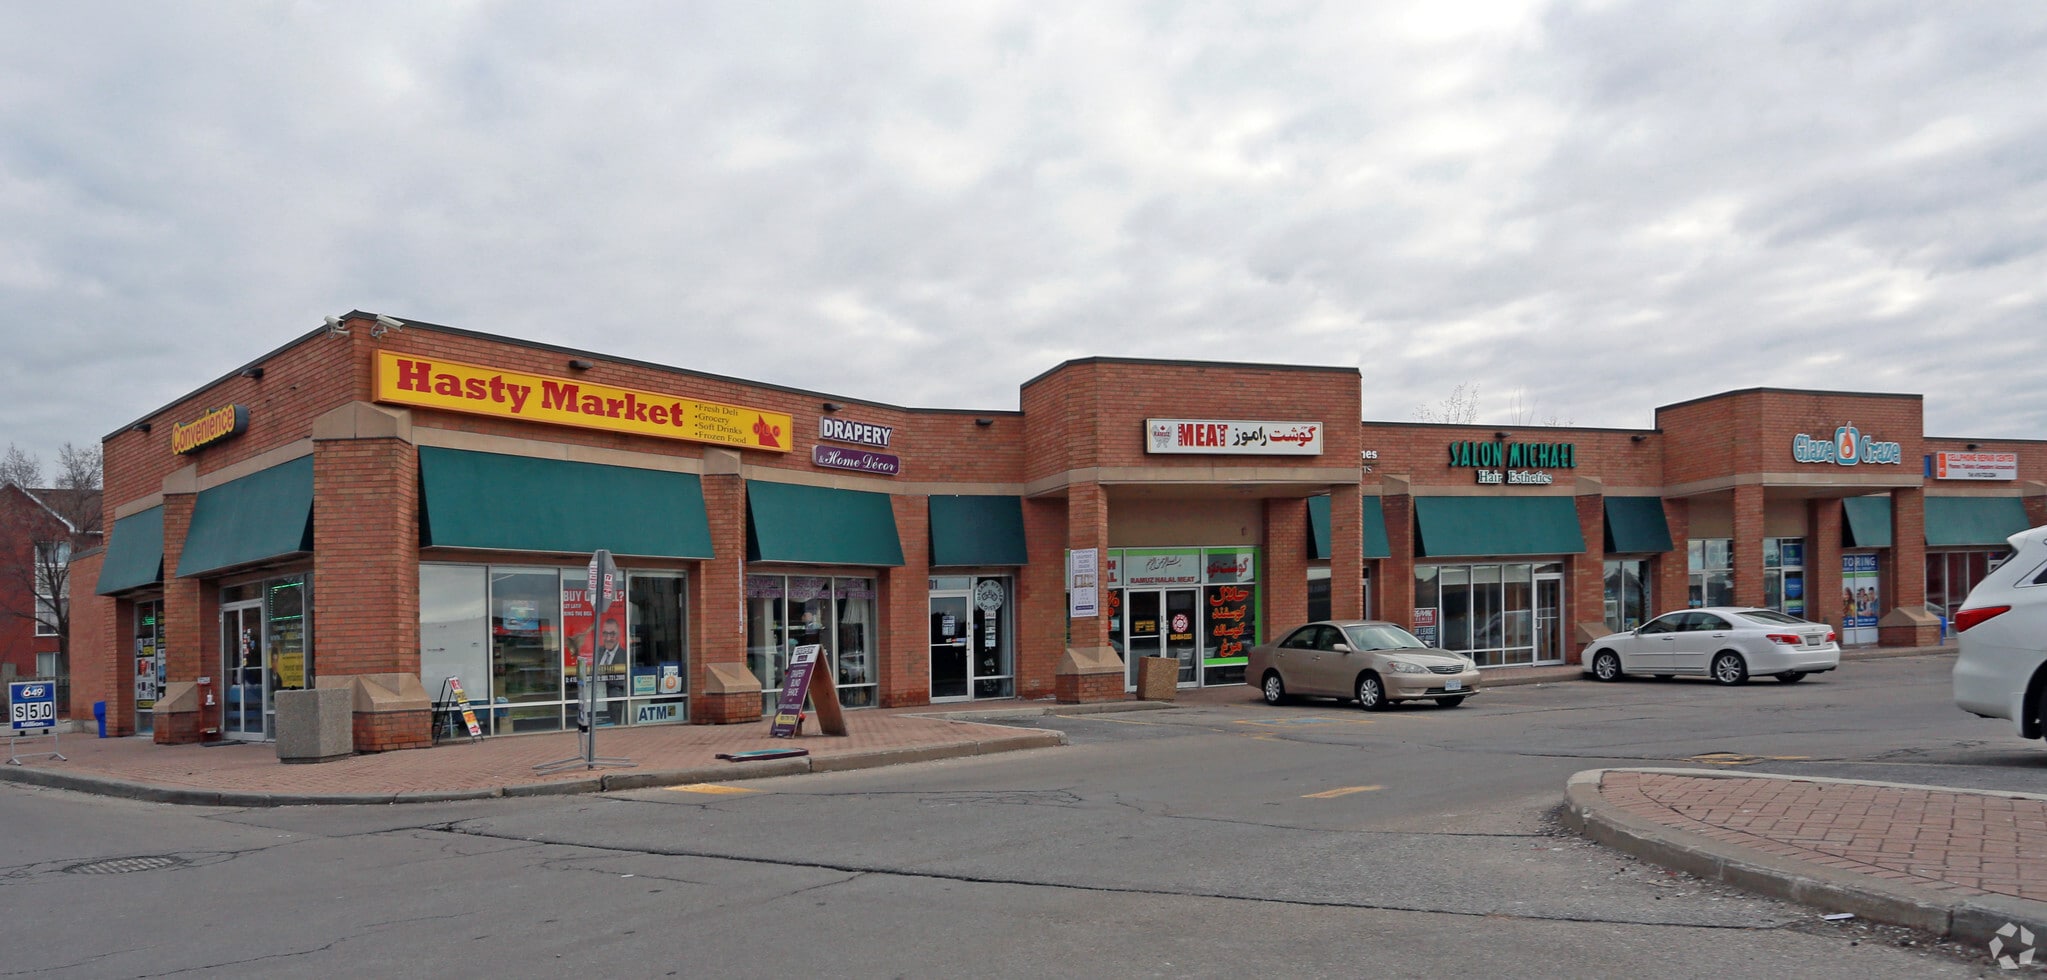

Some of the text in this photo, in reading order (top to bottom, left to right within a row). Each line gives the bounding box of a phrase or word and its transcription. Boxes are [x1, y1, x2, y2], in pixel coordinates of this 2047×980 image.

[397, 359, 683, 427] Hasty Market
[698, 404, 738, 417] Fresh Deli
[698, 413, 729, 426] Grocery
[173, 405, 234, 454] Convenience
[698, 423, 742, 435] Soft Drinks
[698, 431, 747, 444] Frozen Food
[822, 418, 891, 446] DRAPERY
[1177, 423, 1229, 447] MEAT
[1232, 425, 1317, 447] گوشت راموز
[1450, 440, 1578, 468] SALON MICHAEL
[1793, 433, 1901, 465] Glaze Craze
[818, 449, 896, 471] & Home Décor
[1478, 469, 1553, 484] Hair Esthetics
[1130, 575, 1195, 584] RAMUZ HALAL MEAT
[563, 590, 582, 602] BUY
[1209, 585, 1249, 607] حلال
[30, 703, 52, 719] 5.0
[638, 705, 667, 722] ATM
